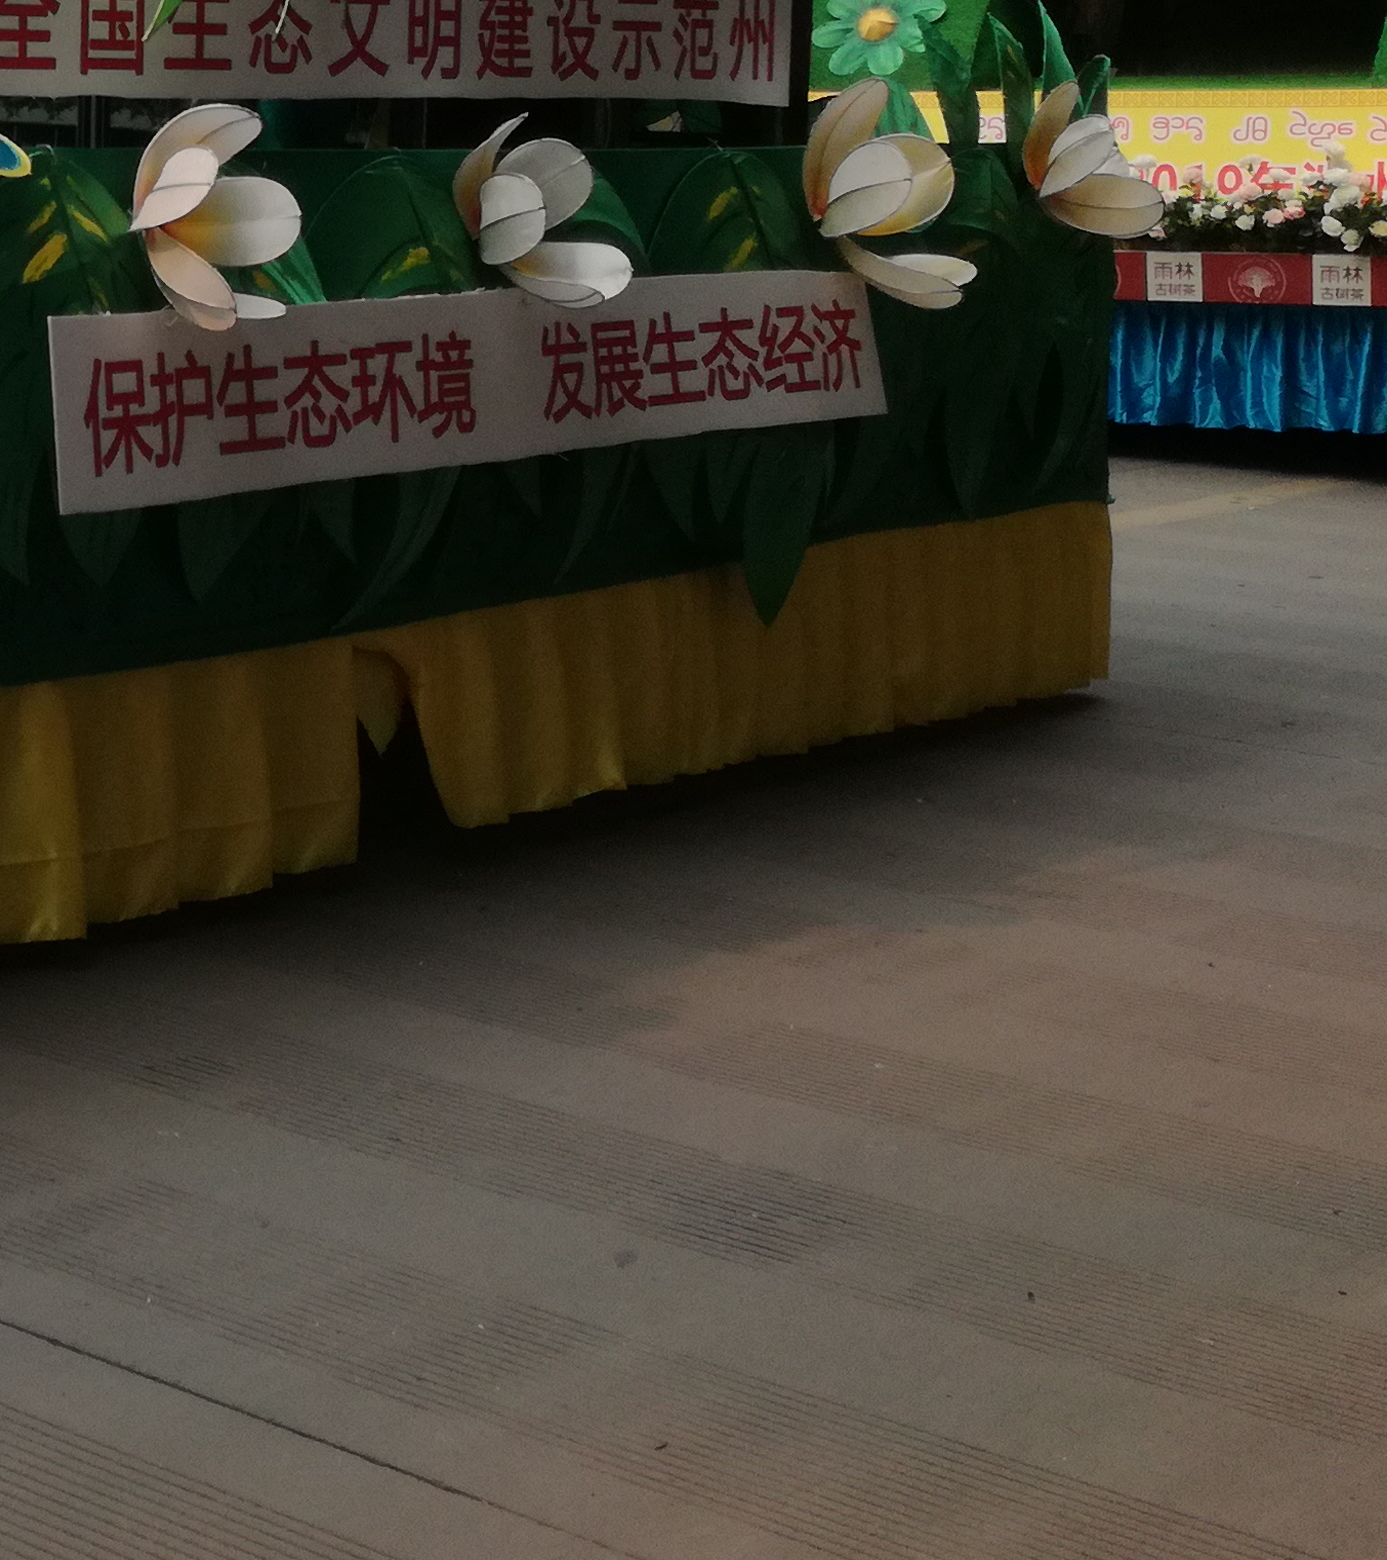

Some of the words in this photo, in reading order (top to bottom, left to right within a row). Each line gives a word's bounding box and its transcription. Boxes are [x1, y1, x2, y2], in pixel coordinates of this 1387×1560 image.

[83, 329, 477, 478] 保护生态环境
[541, 298, 864, 424] 发展生态经济
